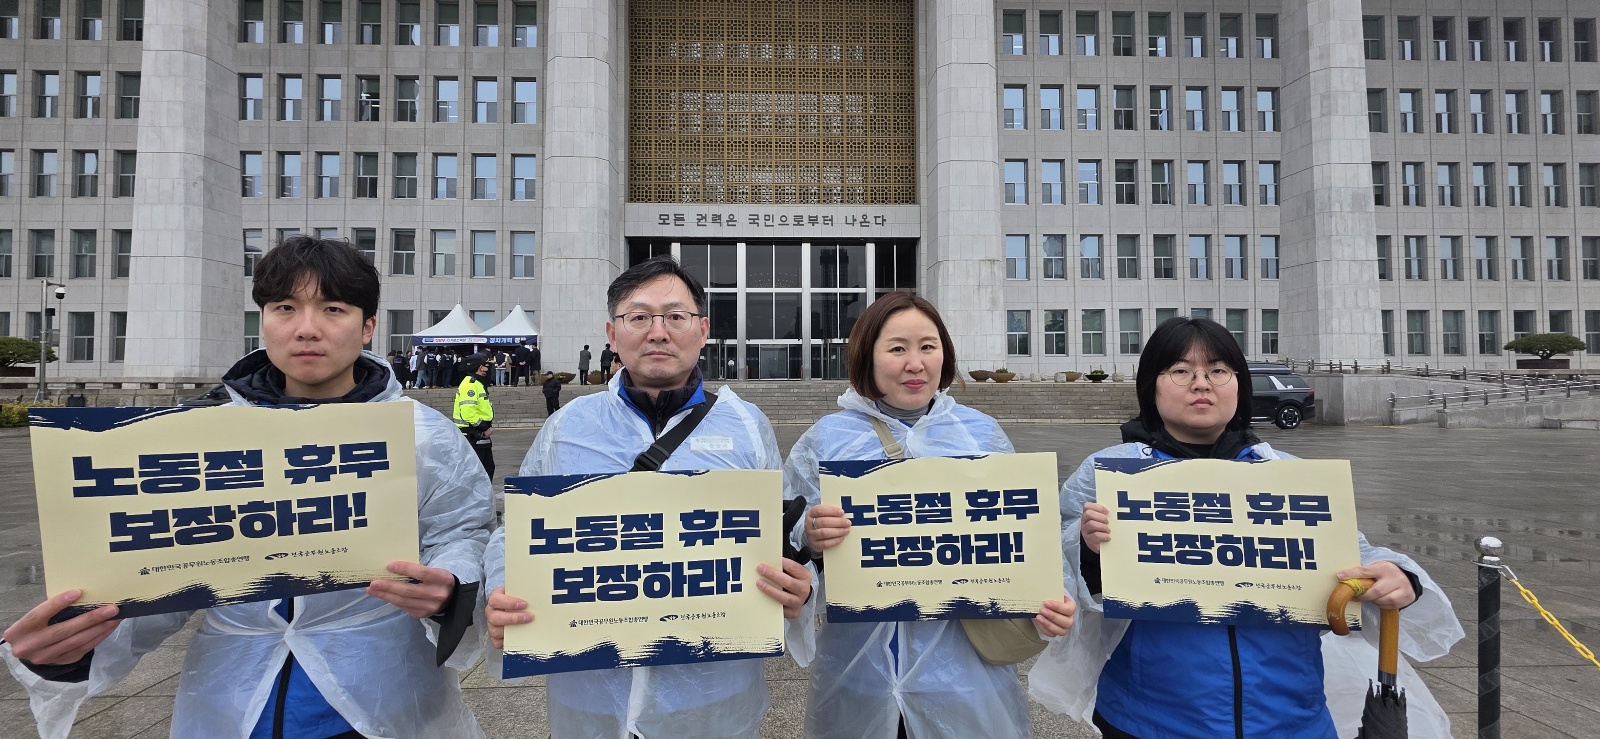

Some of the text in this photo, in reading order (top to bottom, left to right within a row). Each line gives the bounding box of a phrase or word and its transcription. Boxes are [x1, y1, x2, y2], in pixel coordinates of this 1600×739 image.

[658, 214, 886, 227] 모든 권력은 국민으로부터 나온다
[72, 442, 389, 497] 노동절 휴무
[109, 492, 367, 552] 보장하라!
[841, 489, 1039, 526] 노동절 휴무
[1117, 491, 1332, 526] 노동절 휴무
[529, 509, 760, 555] 노동절 휴무
[861, 532, 1024, 568] 보장하라!
[151, 556, 250, 573] 대한민국공무원노동조합총연맹
[1138, 533, 1317, 570] 보장하라!
[552, 557, 742, 604] 보장하라!
